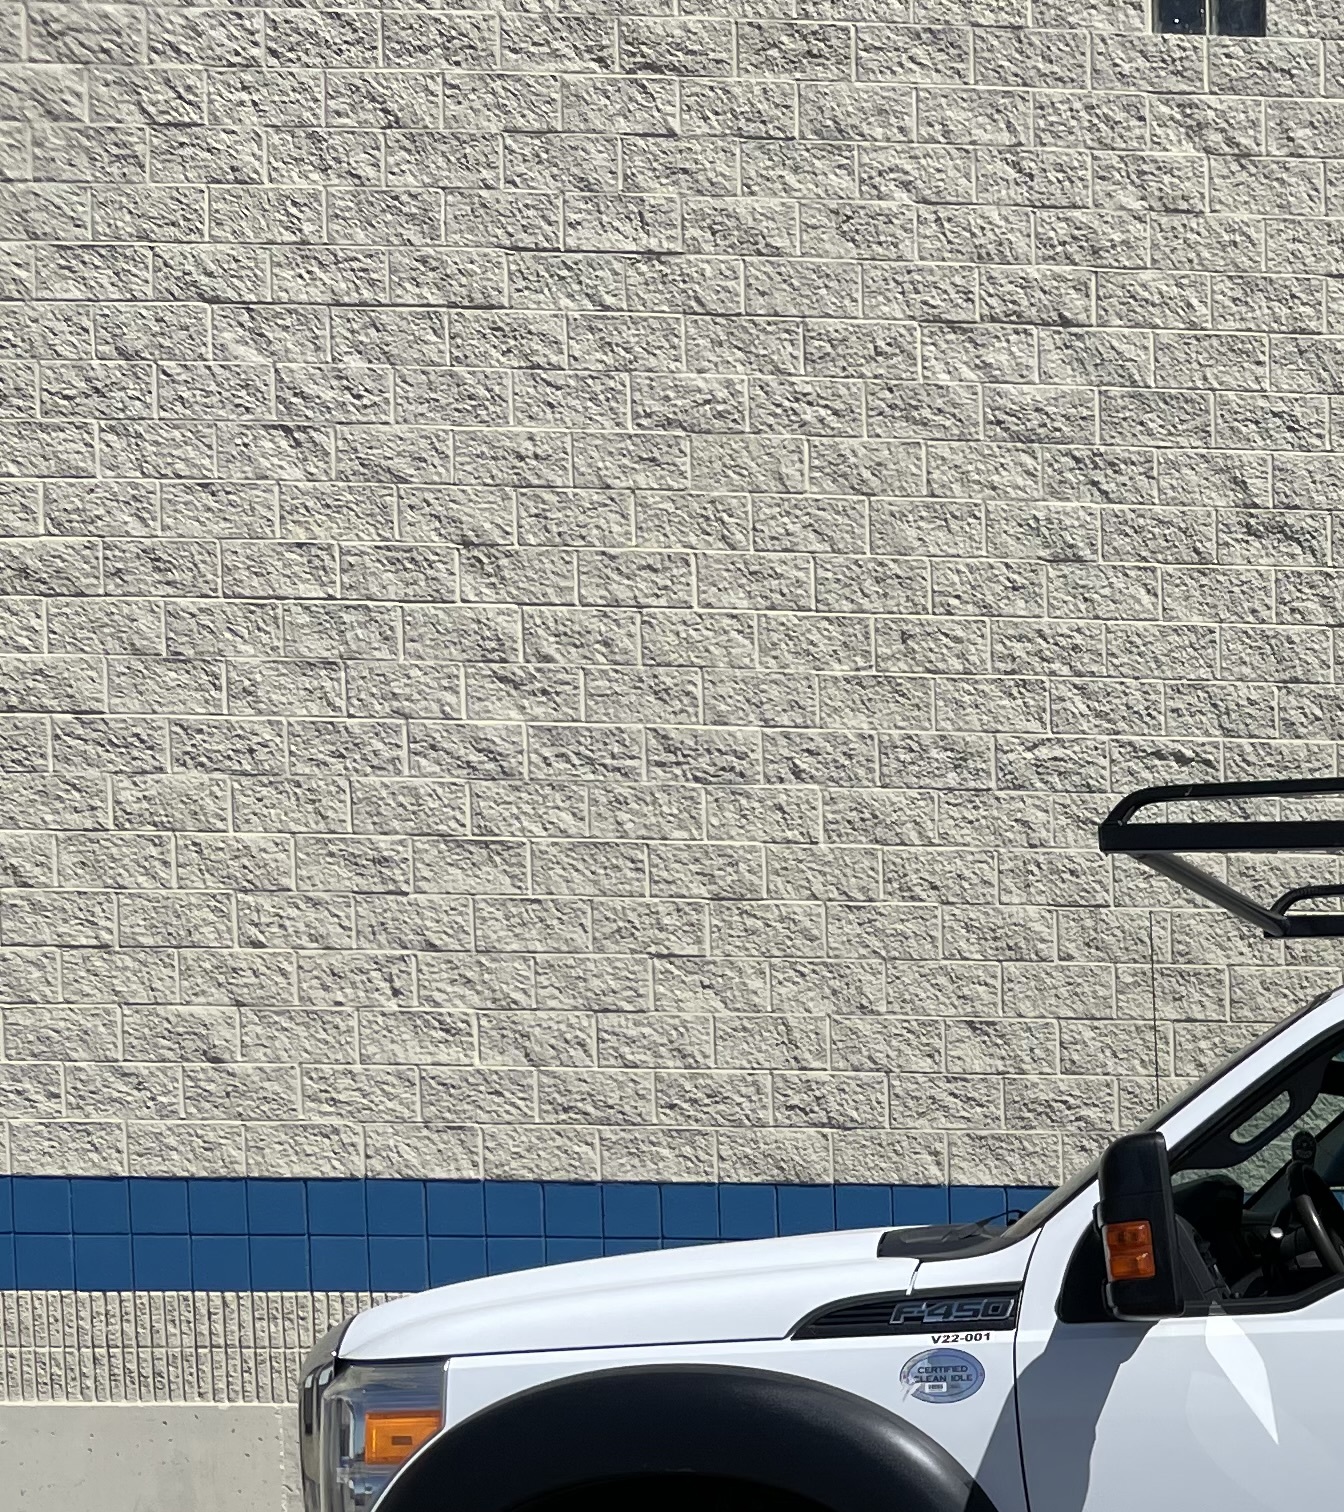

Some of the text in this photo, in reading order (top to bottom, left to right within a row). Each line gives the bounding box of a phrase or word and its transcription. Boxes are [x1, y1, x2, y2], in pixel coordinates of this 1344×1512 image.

[931, 1332, 991, 1345] V22-001
[917, 1365, 969, 1374] CERTIFIED
[951, 1374, 973, 1382] IDLE
